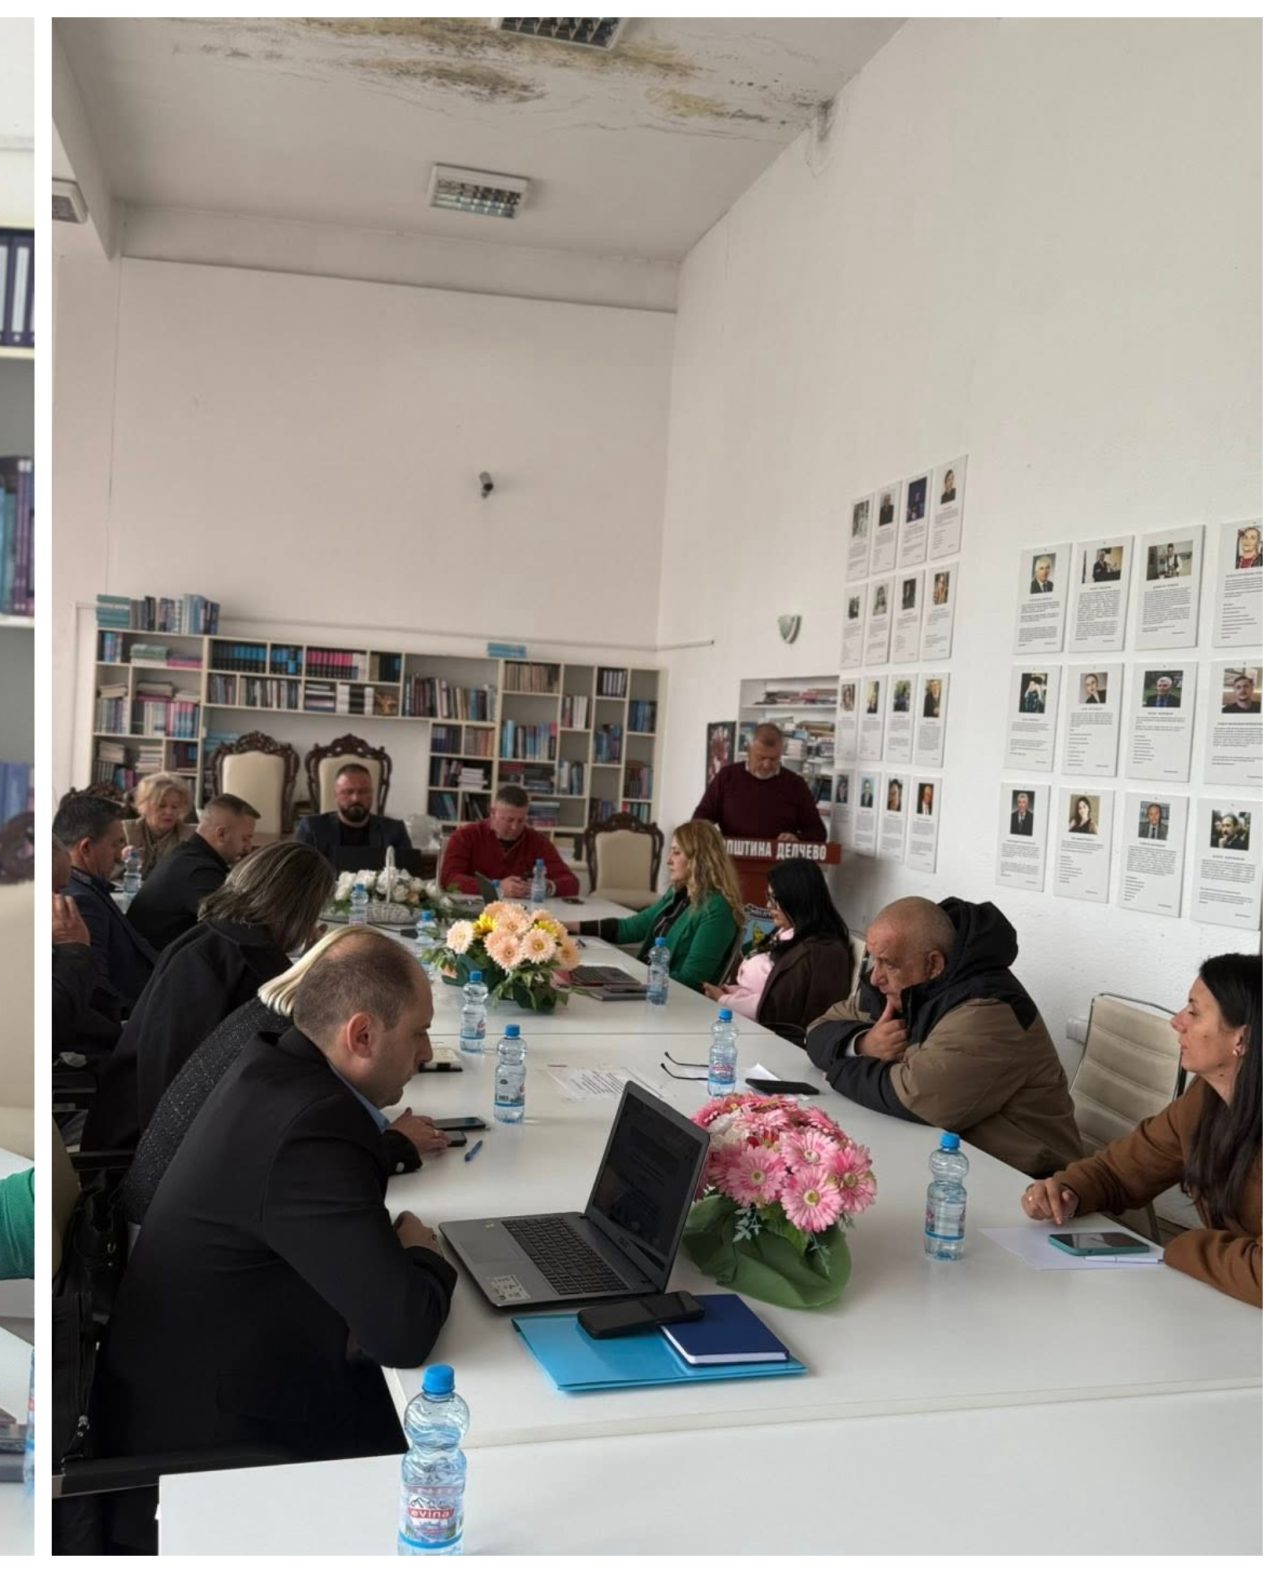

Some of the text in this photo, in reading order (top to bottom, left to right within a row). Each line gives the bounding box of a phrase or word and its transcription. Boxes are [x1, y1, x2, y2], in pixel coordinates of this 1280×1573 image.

[723, 839, 827, 861] ПШТИНА ДЕЛЧЕВО
[410, 1508, 451, 1519] evina
